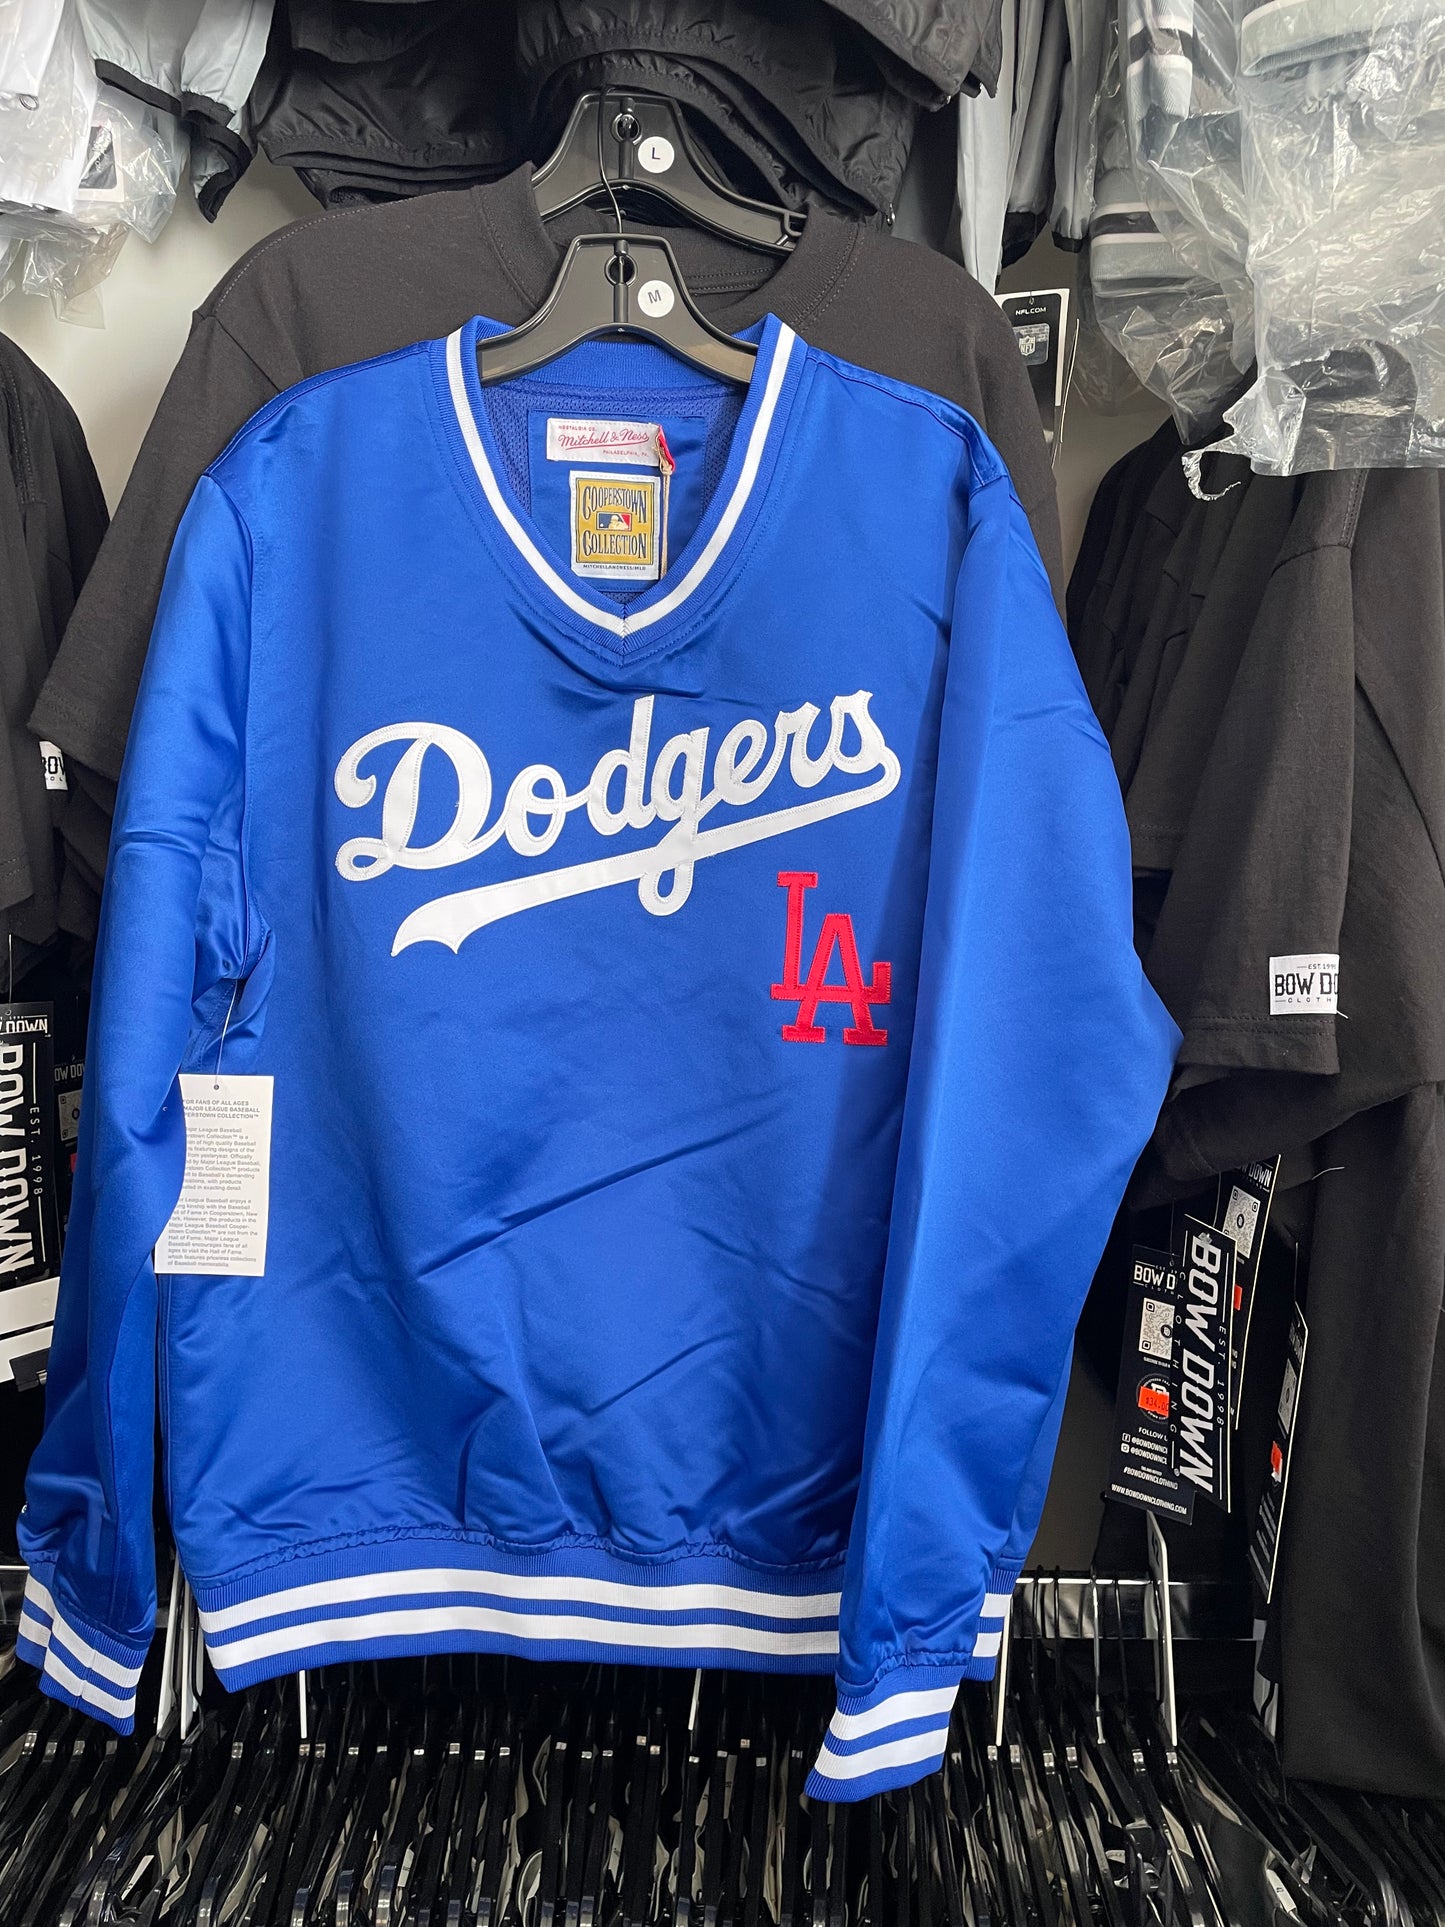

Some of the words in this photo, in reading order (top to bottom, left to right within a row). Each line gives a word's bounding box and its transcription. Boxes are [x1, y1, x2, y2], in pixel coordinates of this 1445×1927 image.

[652, 147, 661, 160] L
[647, 289, 662, 304] M
[1015, 306, 1047, 316] NFL.COM
[1020, 343, 1034, 352] NFL
[558, 431, 610, 447] Mitchell
[610, 432, 619, 442] &
[620, 428, 649, 442] Ness
[583, 486, 647, 523] COOPERSTOWN
[583, 530, 647, 559] COLLECTION
[334, 689, 901, 917] Dodgers
[770, 871, 891, 1046] LA
[1275, 973, 1315, 996] BOW
[31, 1154, 43, 1195] 1998
[1134, 1264, 1165, 1286] BOW
[1185, 1235, 1221, 1352] BOW
[1217, 1325, 1227, 1364] EST.
[1217, 1380, 1225, 1425] 1998
[1138, 1427, 1164, 1439] FOLLOW
[1180, 1348, 1215, 1493] DOWN
[1123, 1466, 1178, 1490] #BOWDOWNCLOTHING
[1111, 1483, 1187, 1515] WWW.BOWDOWNCLOTHING.COM
